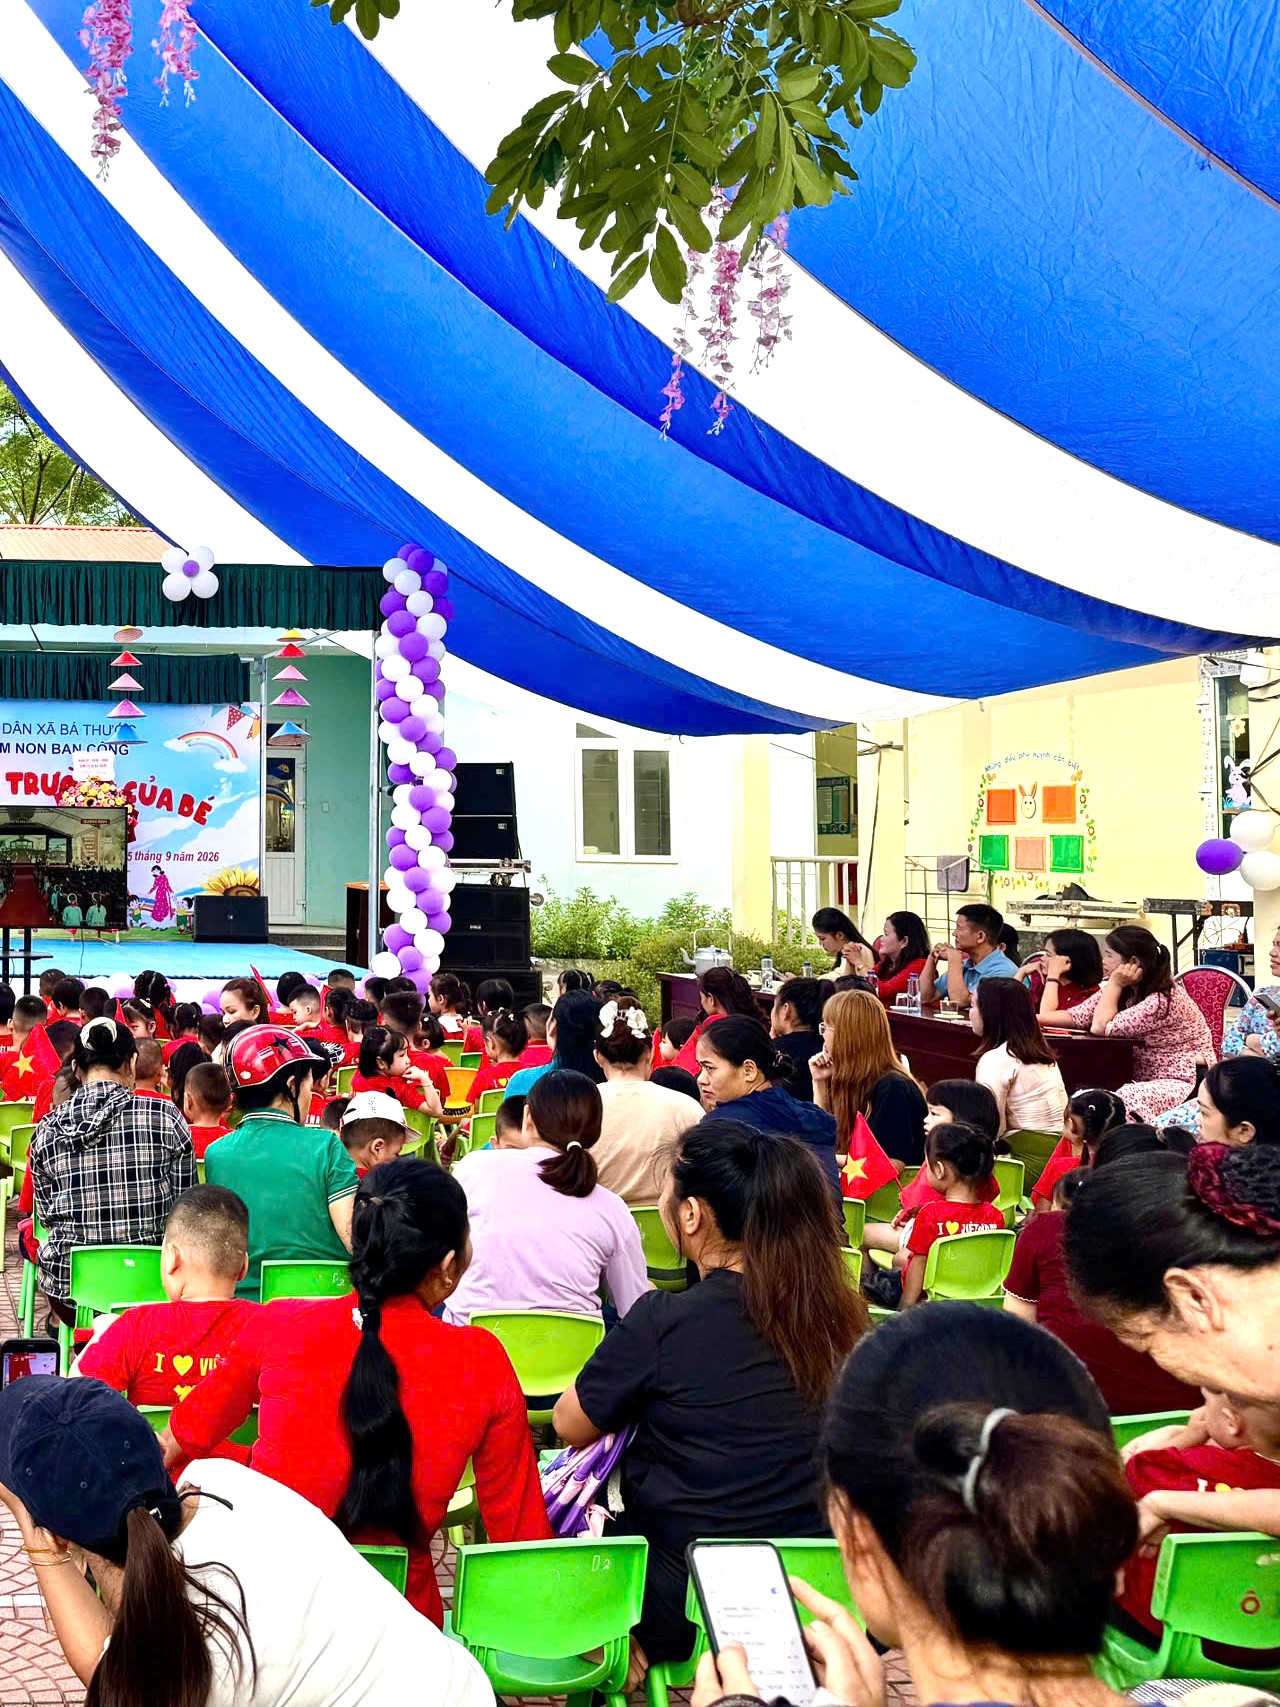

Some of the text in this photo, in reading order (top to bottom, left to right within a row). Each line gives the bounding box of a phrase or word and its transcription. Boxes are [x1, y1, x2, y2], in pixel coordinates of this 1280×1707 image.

[2, 721, 32, 735] DÂN
[36, 721, 56, 735] XÃ
[60, 721, 79, 736] BÁ
[15, 742, 47, 754] NON
[177, 795, 215, 826] BÉ
[135, 851, 162, 863] tháng
[166, 851, 172, 862] 9
[173, 851, 194, 861] năm
[197, 852, 220, 862] 2026
